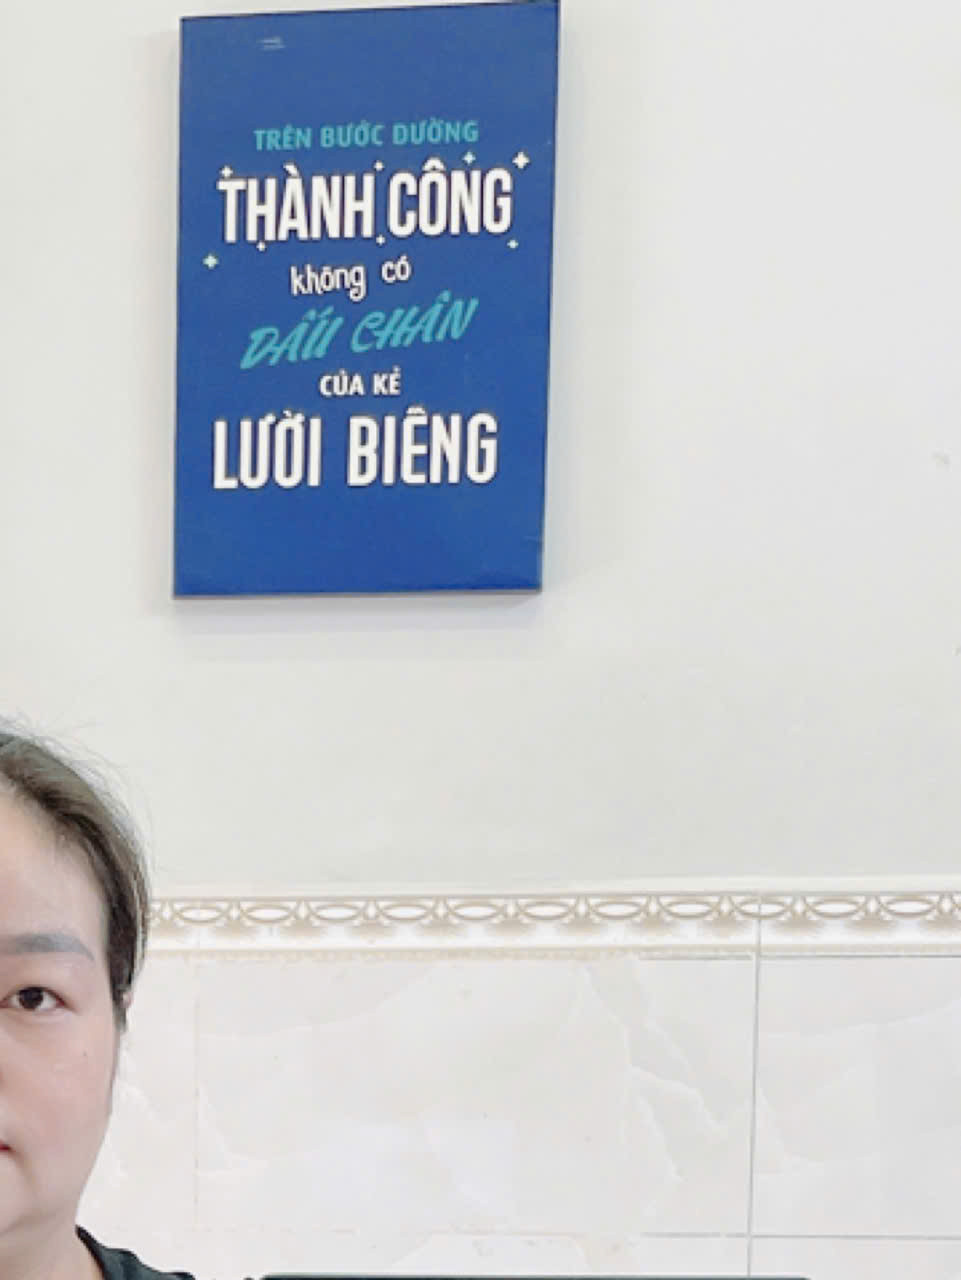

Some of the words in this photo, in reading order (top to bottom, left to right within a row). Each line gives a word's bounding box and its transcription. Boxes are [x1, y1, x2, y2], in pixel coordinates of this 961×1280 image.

[217, 163, 375, 243] THÀNH
[387, 156, 514, 237] CÔNG
[290, 264, 367, 302] không
[381, 254, 413, 284] có
[213, 409, 323, 490] LƯỜI
